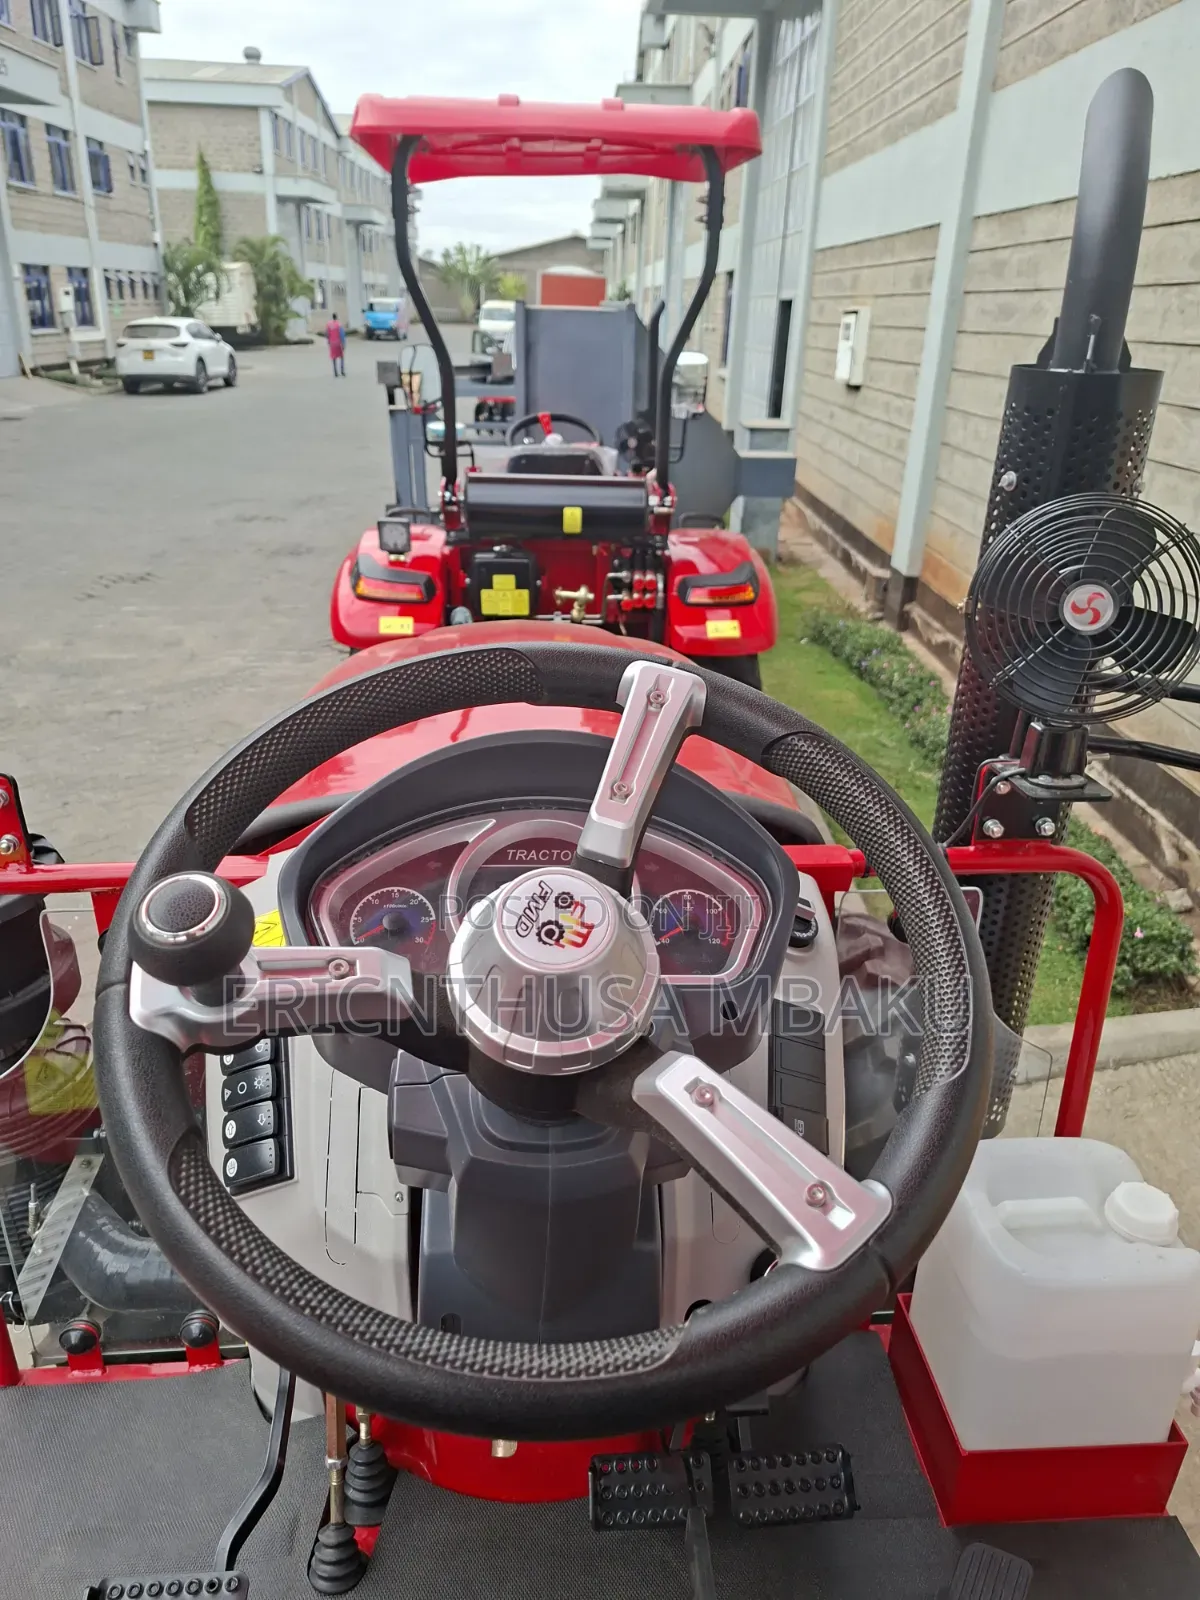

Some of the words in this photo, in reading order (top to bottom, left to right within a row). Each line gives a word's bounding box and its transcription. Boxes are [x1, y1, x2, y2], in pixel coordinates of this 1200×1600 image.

[506, 849, 577, 861] TRACTO
[409, 898, 419, 906] 20
[516, 880, 553, 938] FMD
[421, 916, 430, 924] 25
